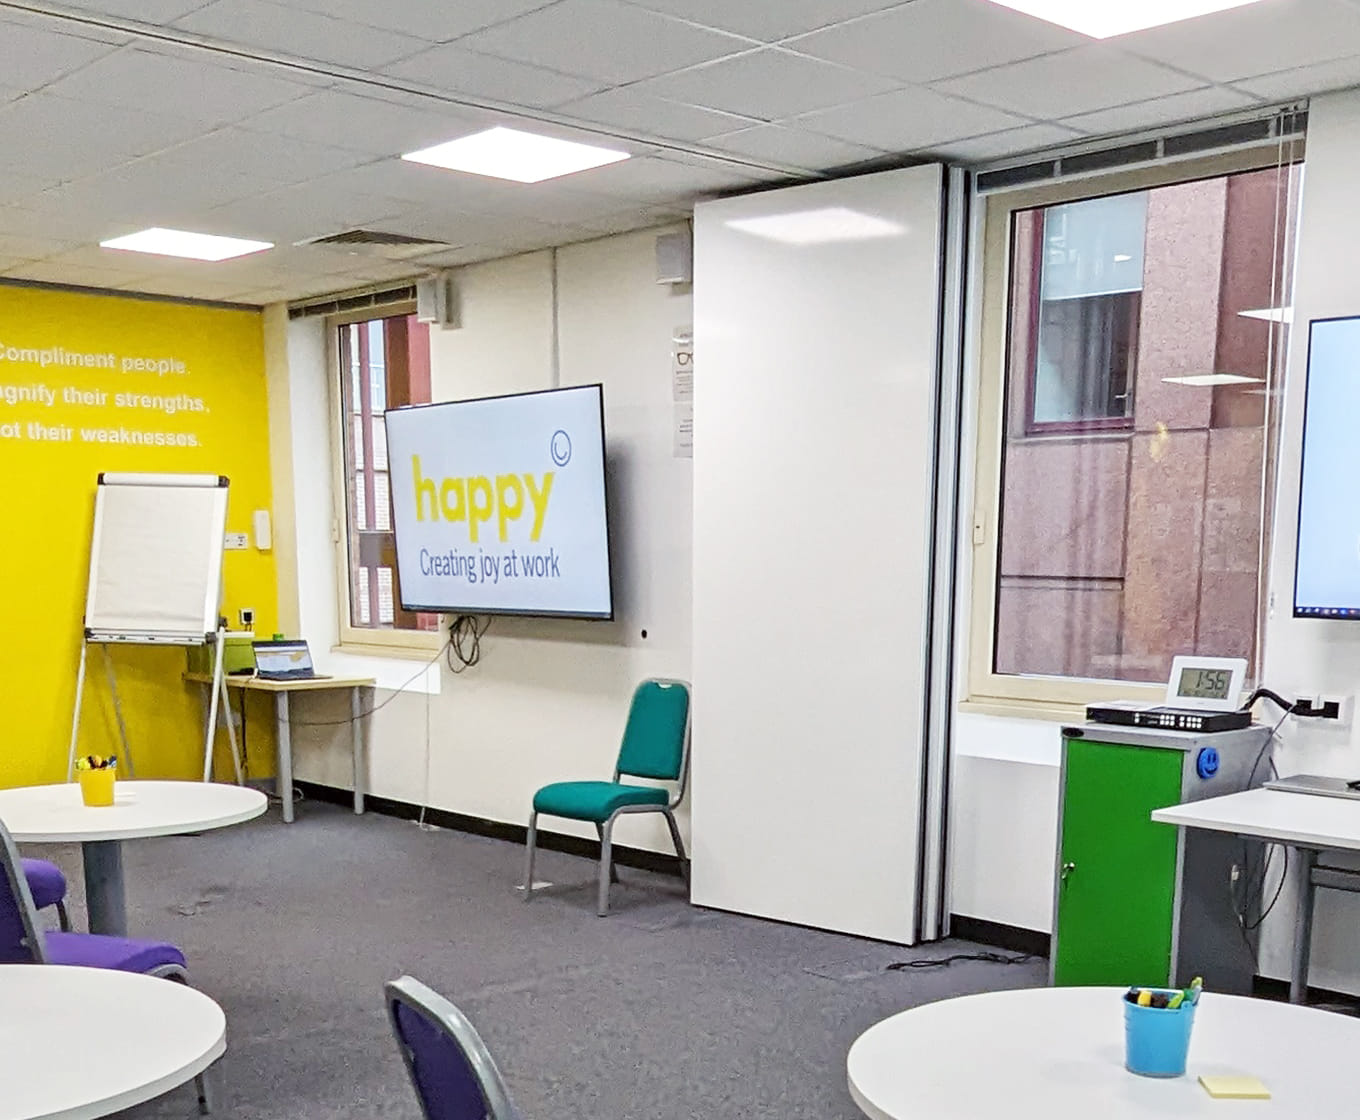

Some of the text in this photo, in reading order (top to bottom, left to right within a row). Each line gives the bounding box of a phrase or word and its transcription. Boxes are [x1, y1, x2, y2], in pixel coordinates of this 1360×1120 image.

[62, 386, 108, 405] their
[27, 422, 74, 442] their
[80, 427, 203, 447] weaknesses.
[411, 454, 555, 543] happy
[419, 547, 561, 584] Creating joy at work
